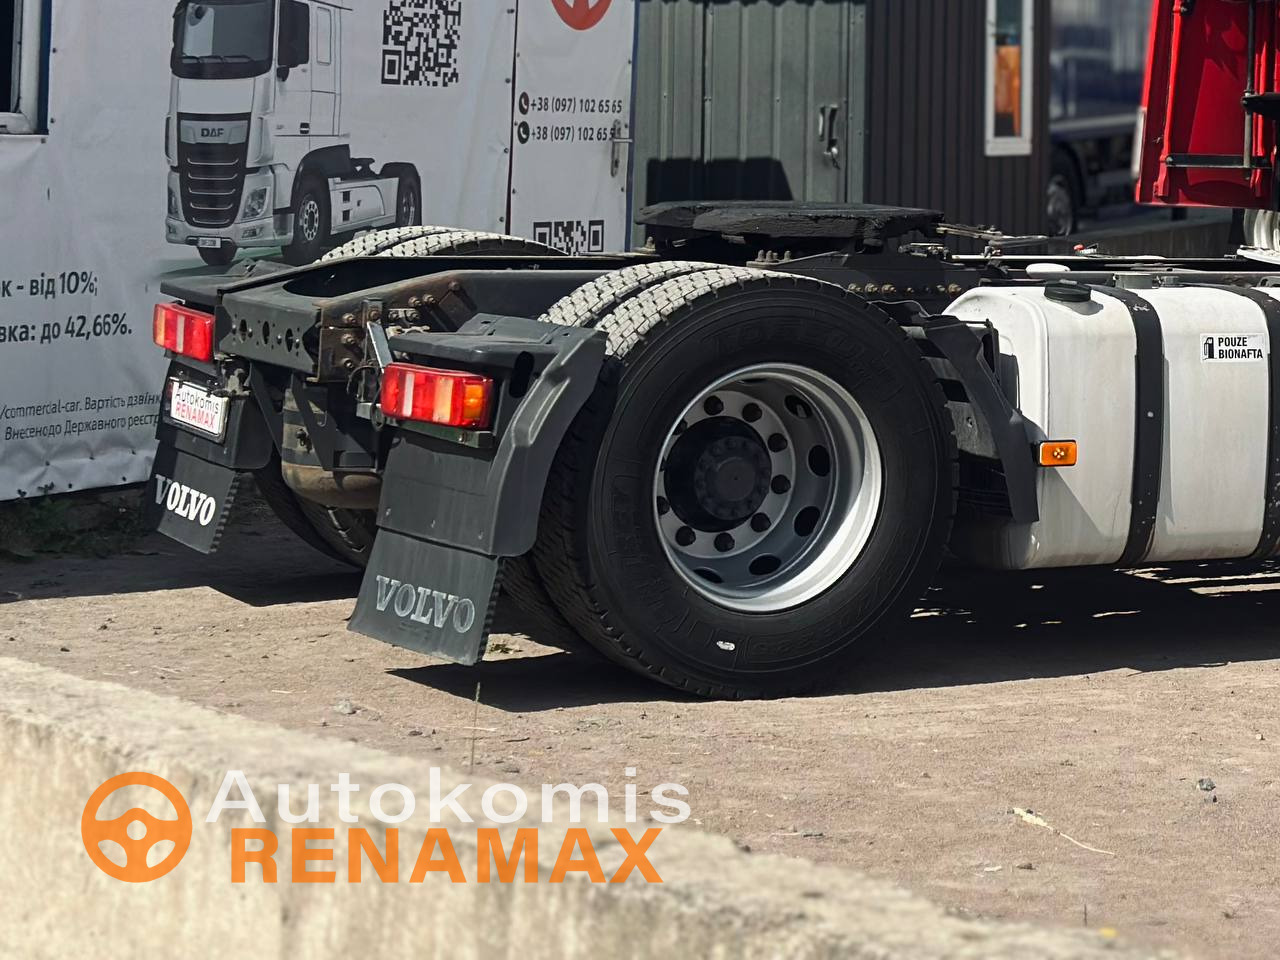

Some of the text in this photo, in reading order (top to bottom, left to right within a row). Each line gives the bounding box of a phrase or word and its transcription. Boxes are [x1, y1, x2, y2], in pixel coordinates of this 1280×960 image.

[530, 96, 623, 114] +38 (097) 102 65 65
[200, 127, 225, 138] DAF
[531, 126, 548, 141] +38
[550, 125, 575, 142] (097)
[578, 127, 595, 141] 102
[596, 127, 608, 141] 65
[0, 280, 12, 297] к
[29, 272, 56, 300] від
[59, 271, 98, 297] 10%;
[40, 322, 61, 344] до
[64, 312, 133, 341] 42,66%.
[1218, 337, 1248, 347] POUZE
[1218, 348, 1264, 359] BIONAFTA
[84, 396, 126, 413] Вартість
[175, 387, 219, 415] Autokomis
[175, 401, 216, 430] RENAMAX
[64, 417, 127, 435] Державного
[155, 473, 216, 526] VOLVO
[376, 575, 475, 633] VOLVO
